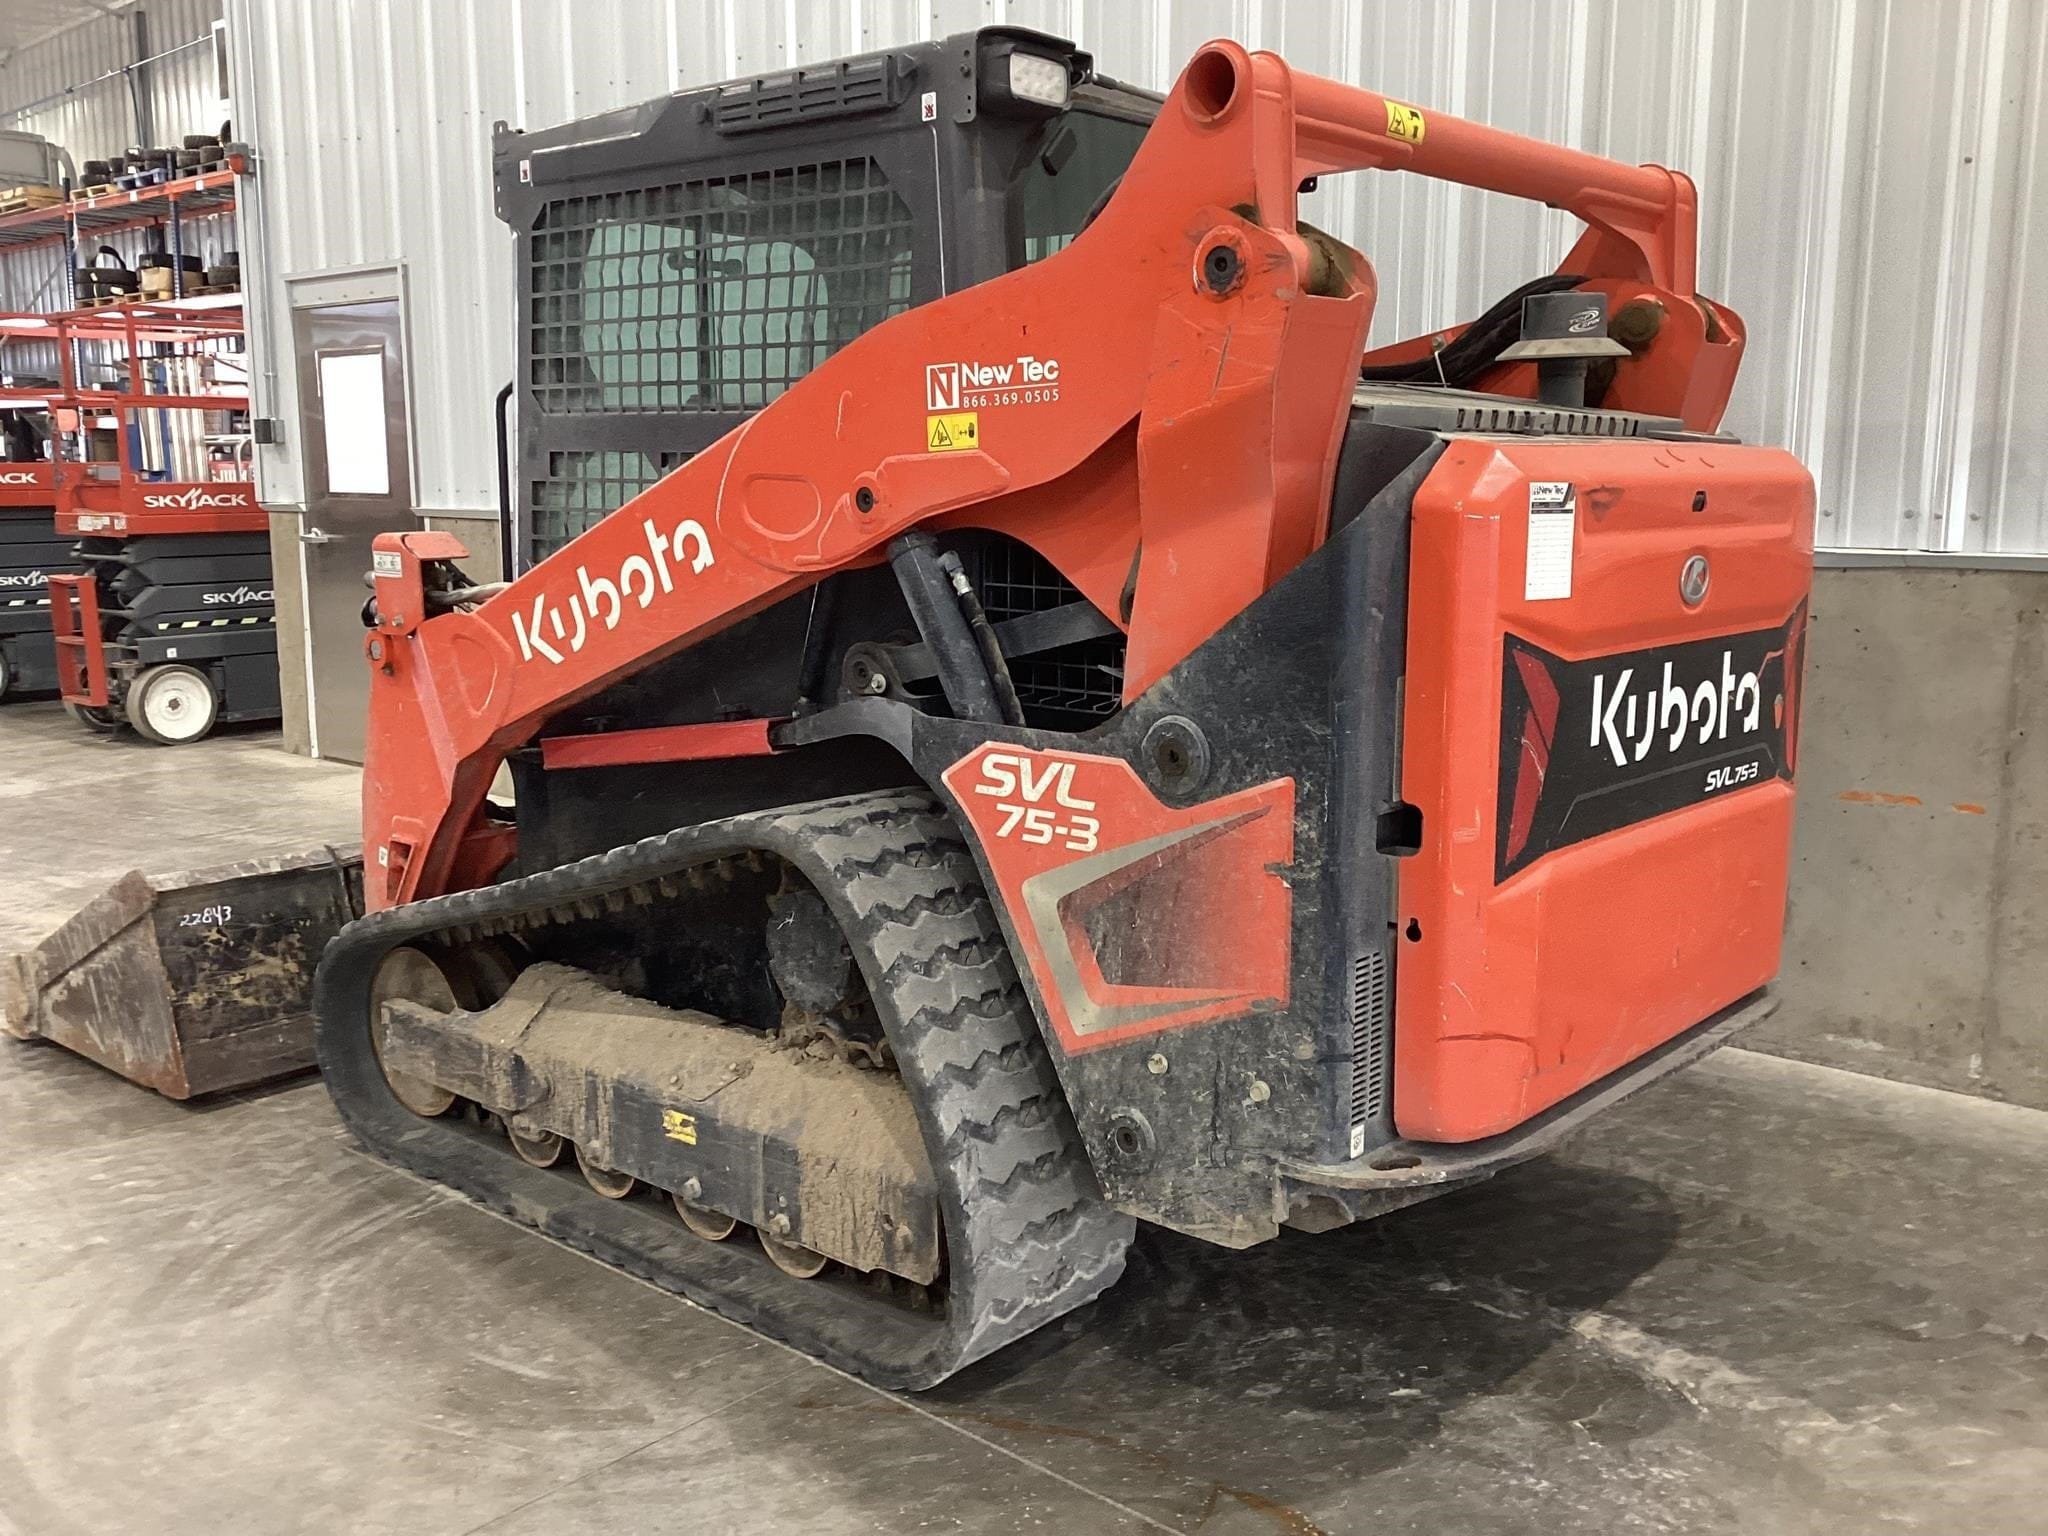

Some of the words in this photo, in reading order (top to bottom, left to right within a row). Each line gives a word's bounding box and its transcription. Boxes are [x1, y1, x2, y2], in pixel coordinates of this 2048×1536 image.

[961, 361, 1014, 387] New
[1016, 356, 1060, 383] Tec
[962, 388, 1060, 409] 866.369.0505
[143, 487, 248, 510] SKYJACK
[511, 518, 715, 665] Kubota
[1590, 650, 1761, 767] Kubota
[974, 753, 1096, 812] SVL
[995, 802, 1100, 852] 75-3
[179, 905, 232, 927] 22843
